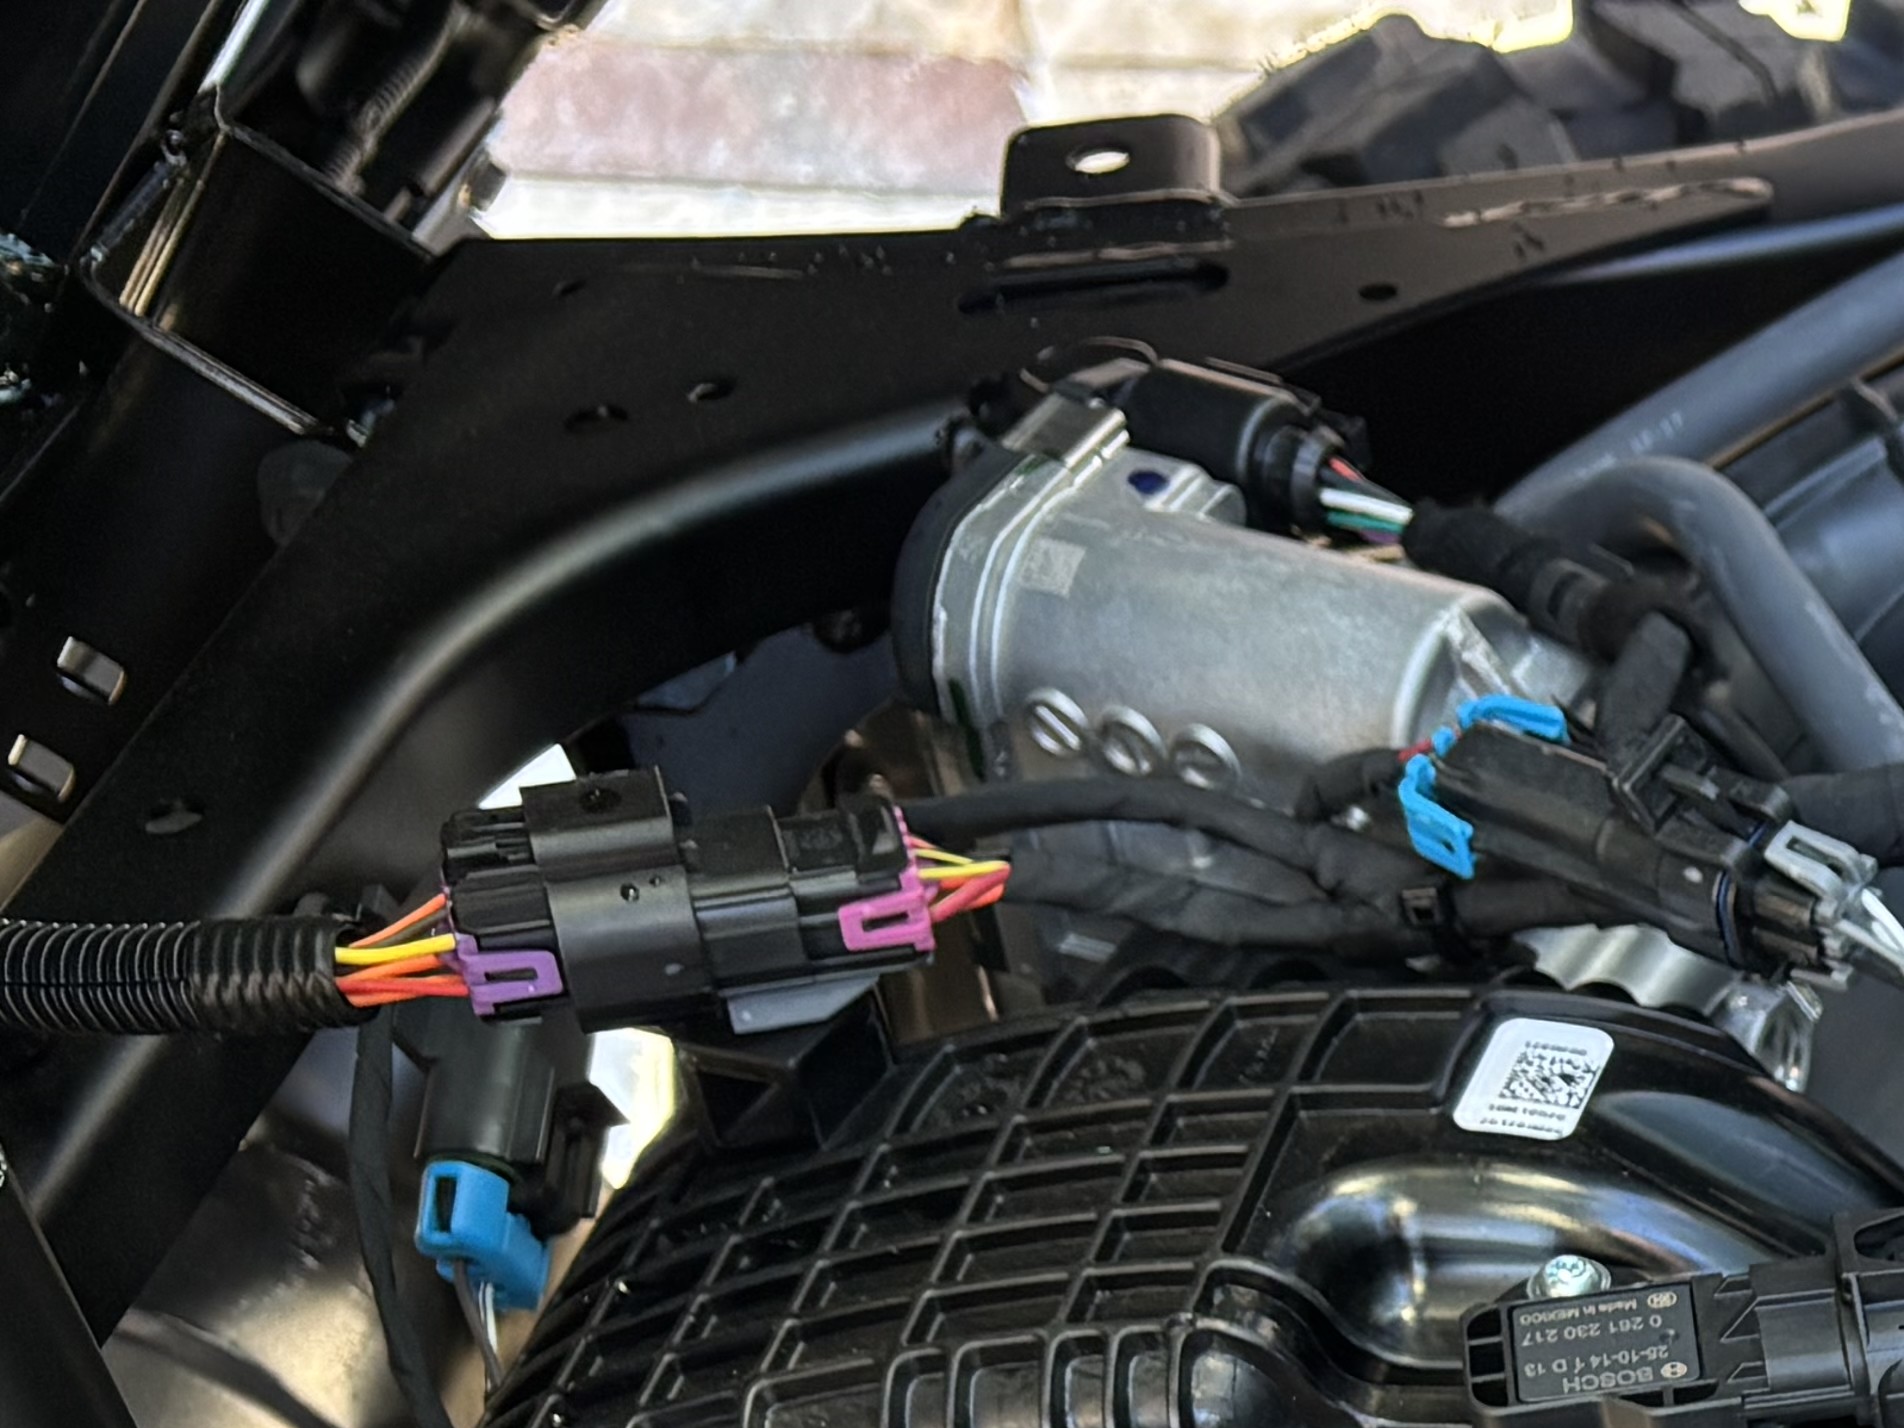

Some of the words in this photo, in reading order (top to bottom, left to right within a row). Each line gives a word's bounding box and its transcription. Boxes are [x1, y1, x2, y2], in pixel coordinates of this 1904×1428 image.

[1598, 1298, 1638, 1314] Made
[1519, 1308, 1580, 1326] MEXICO
[1608, 1316, 1644, 1335] 261
[1650, 1314, 1662, 1328] 0
[1520, 1328, 1559, 1347] 217
[1563, 1322, 1601, 1341] 230
[1590, 1344, 1670, 1368] 25-10-14
[1524, 1362, 1547, 1378] 13
[1552, 1358, 1568, 1373] D
[1562, 1366, 1654, 1394] BOSCH
